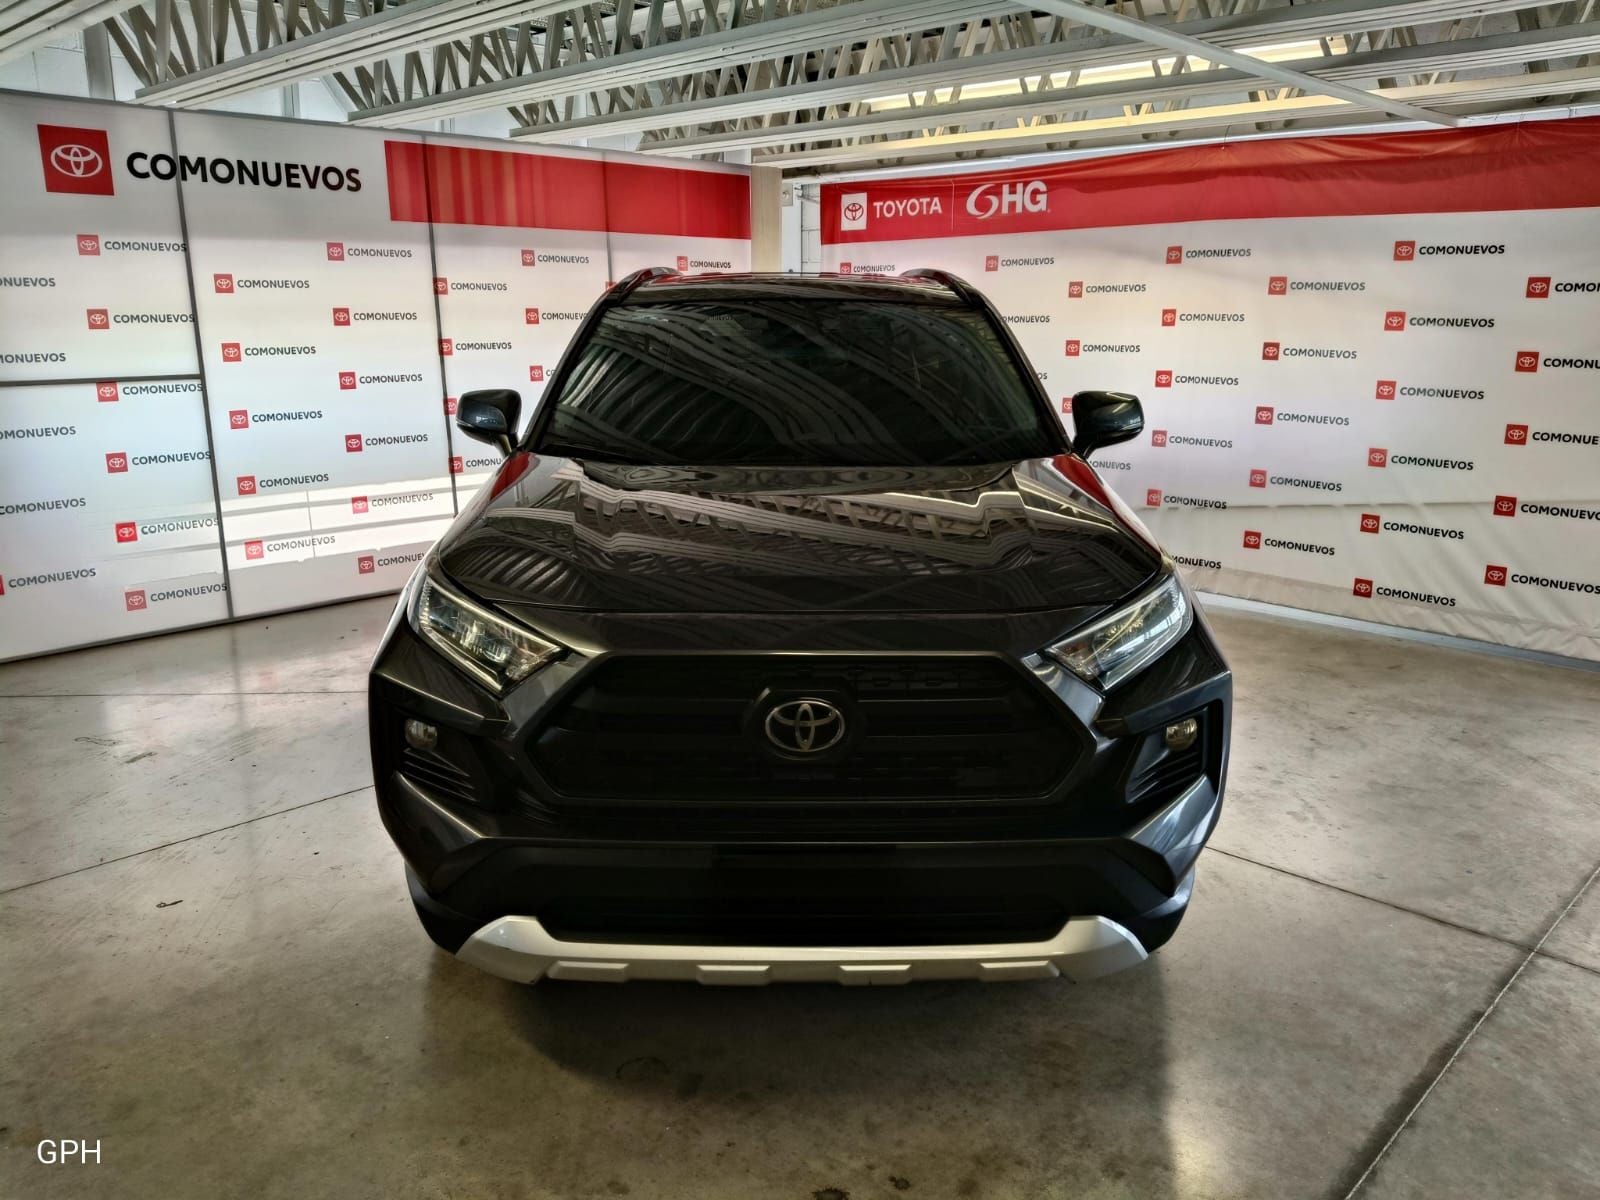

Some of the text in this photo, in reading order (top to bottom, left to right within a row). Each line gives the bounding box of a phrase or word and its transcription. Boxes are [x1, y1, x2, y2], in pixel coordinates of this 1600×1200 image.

[126, 151, 362, 192] COMONUEVOS
[873, 197, 943, 218] TOYOTA
[104, 240, 187, 253] COMONUEVOS
[1186, 247, 1252, 258] COMONUEVOS
[1419, 243, 1506, 256] COMONUEVOS
[347, 248, 412, 258] COMONUEVOS
[537, 254, 590, 264] COMONUEVOS
[690, 260, 731, 269] COMONUEVOS
[1000, 258, 1055, 266] COMONUEVOS
[853, 265, 895, 273] COMONUEVOS
[237, 279, 310, 289] COMONUEVOS
[450, 282, 508, 292] COMONUEVOS
[1085, 285, 1147, 294] COMONUEVOS
[1290, 281, 1366, 292] COMONUEVOS
[113, 313, 195, 324] COMONUEVOS
[353, 312, 418, 321] COMONUEVOS
[1179, 314, 1246, 323] COMONUEVOS
[1409, 317, 1495, 328] COMONUEVOS
[244, 346, 316, 357] COMONUEVOS
[455, 341, 512, 351] COMONUEVOS
[1082, 344, 1141, 353] COMONUEVOS
[1283, 348, 1358, 360] COMONUEVOS
[359, 374, 423, 385] COMONUEVOS
[1175, 375, 1240, 387] COMONUEVOS
[122, 384, 203, 396] COMONUEVOS
[1400, 386, 1485, 400] COMONUEVOS
[251, 410, 323, 422] COMONUEVOS
[1277, 412, 1350, 426] COMONUEVOS
[365, 434, 428, 447] COMONUEVOS
[1169, 436, 1233, 449] COMONUEVOS
[131, 451, 211, 466] COMONUEVOS
[465, 457, 502, 468] COMONU
[1390, 455, 1475, 471] COMONUEVOS
[1091, 460, 1131, 471] ONUEVOS
[259, 473, 329, 489] COMONUEVOS
[1270, 476, 1343, 492] COMONUEVOS
[371, 493, 433, 508] COMONUEVOS
[1163, 495, 1228, 511] COMONUEVOS
[1383, 521, 1465, 540] COMONUEVOS
[266, 536, 336, 552] COMONUEVOS
[1264, 538, 1336, 556] COMONUEVOS
[8, 568, 96, 587] COMONUEVOS
[150, 583, 227, 602] COMONUEVOS
[1376, 586, 1457, 607] COMONUEVOS
